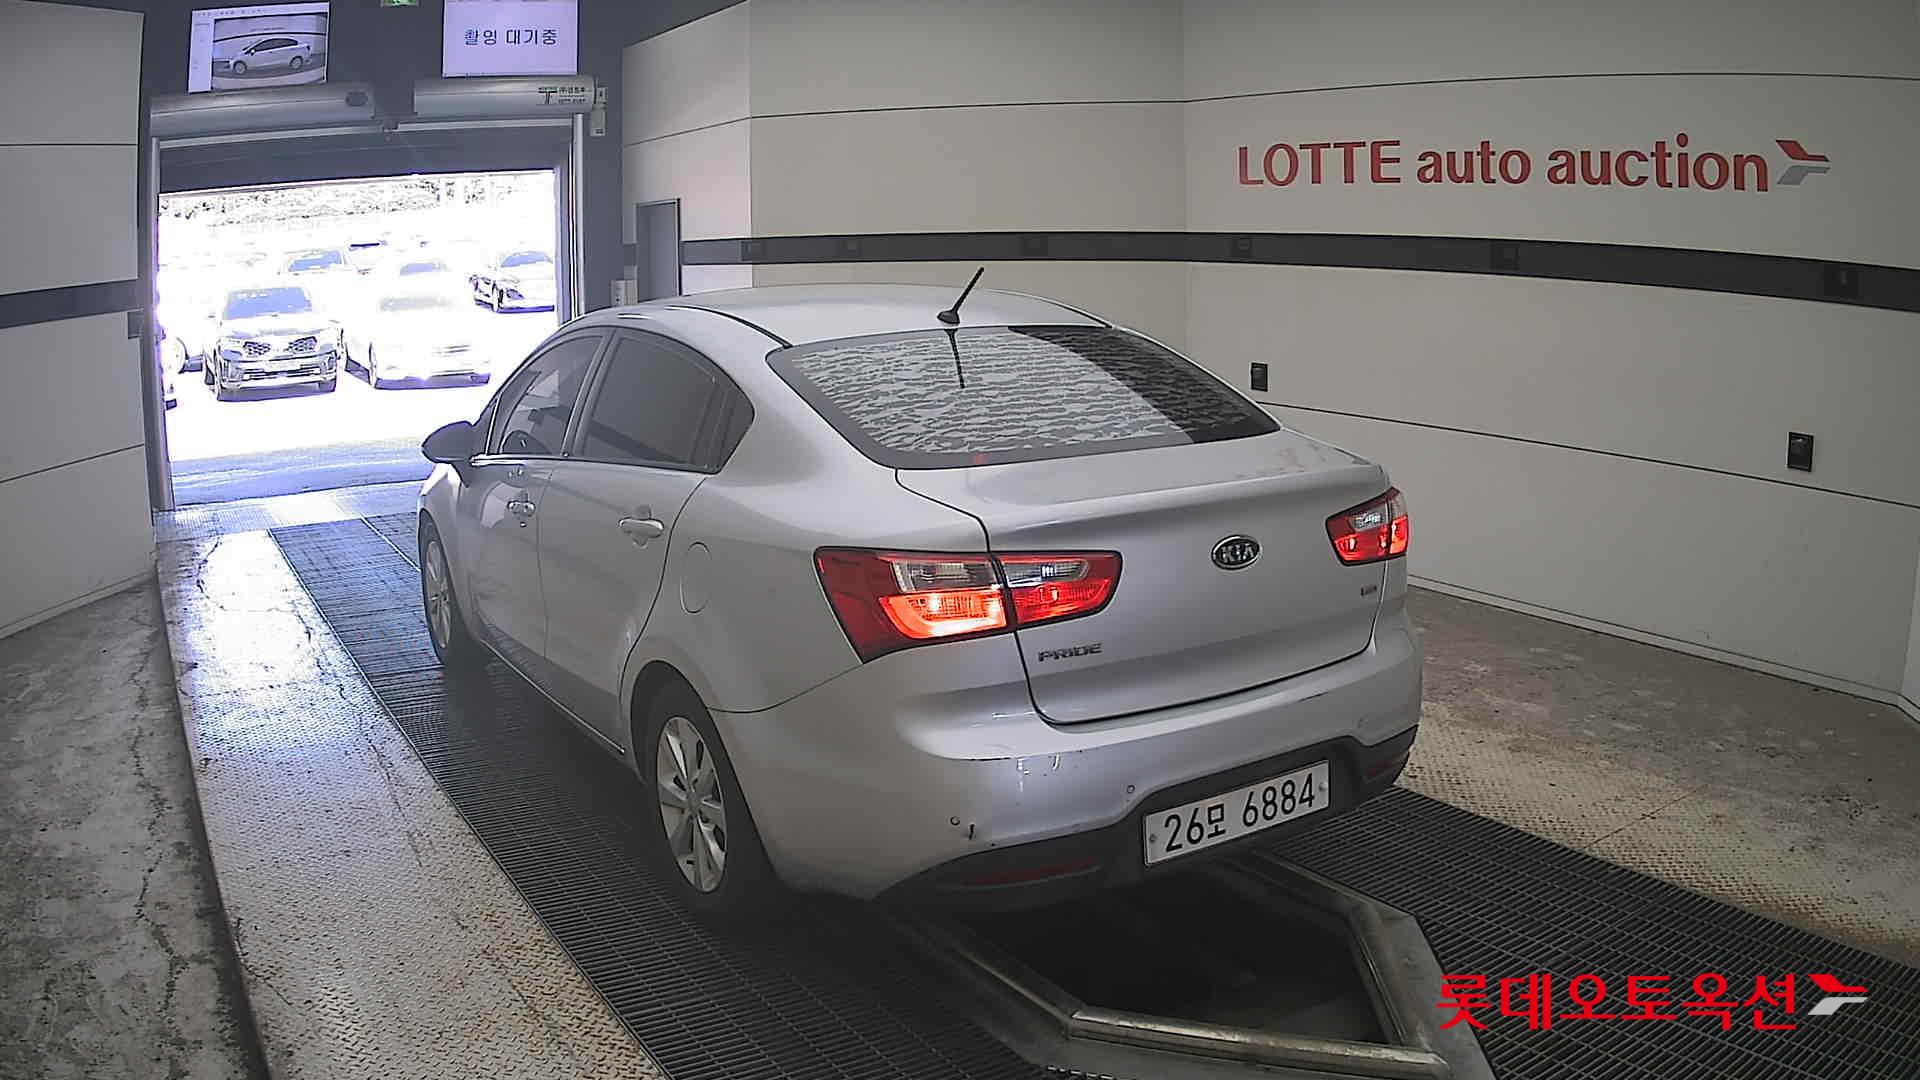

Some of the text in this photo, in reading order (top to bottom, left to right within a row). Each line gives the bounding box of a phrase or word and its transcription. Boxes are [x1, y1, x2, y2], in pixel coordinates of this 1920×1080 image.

[506, 29, 558, 45] 대기중
[1238, 133, 1768, 192] LOTTE auto auction
[1220, 542, 1255, 563] KIA
[1038, 643, 1103, 662] PRIDE
[1164, 772, 1315, 852] 26모 6884
